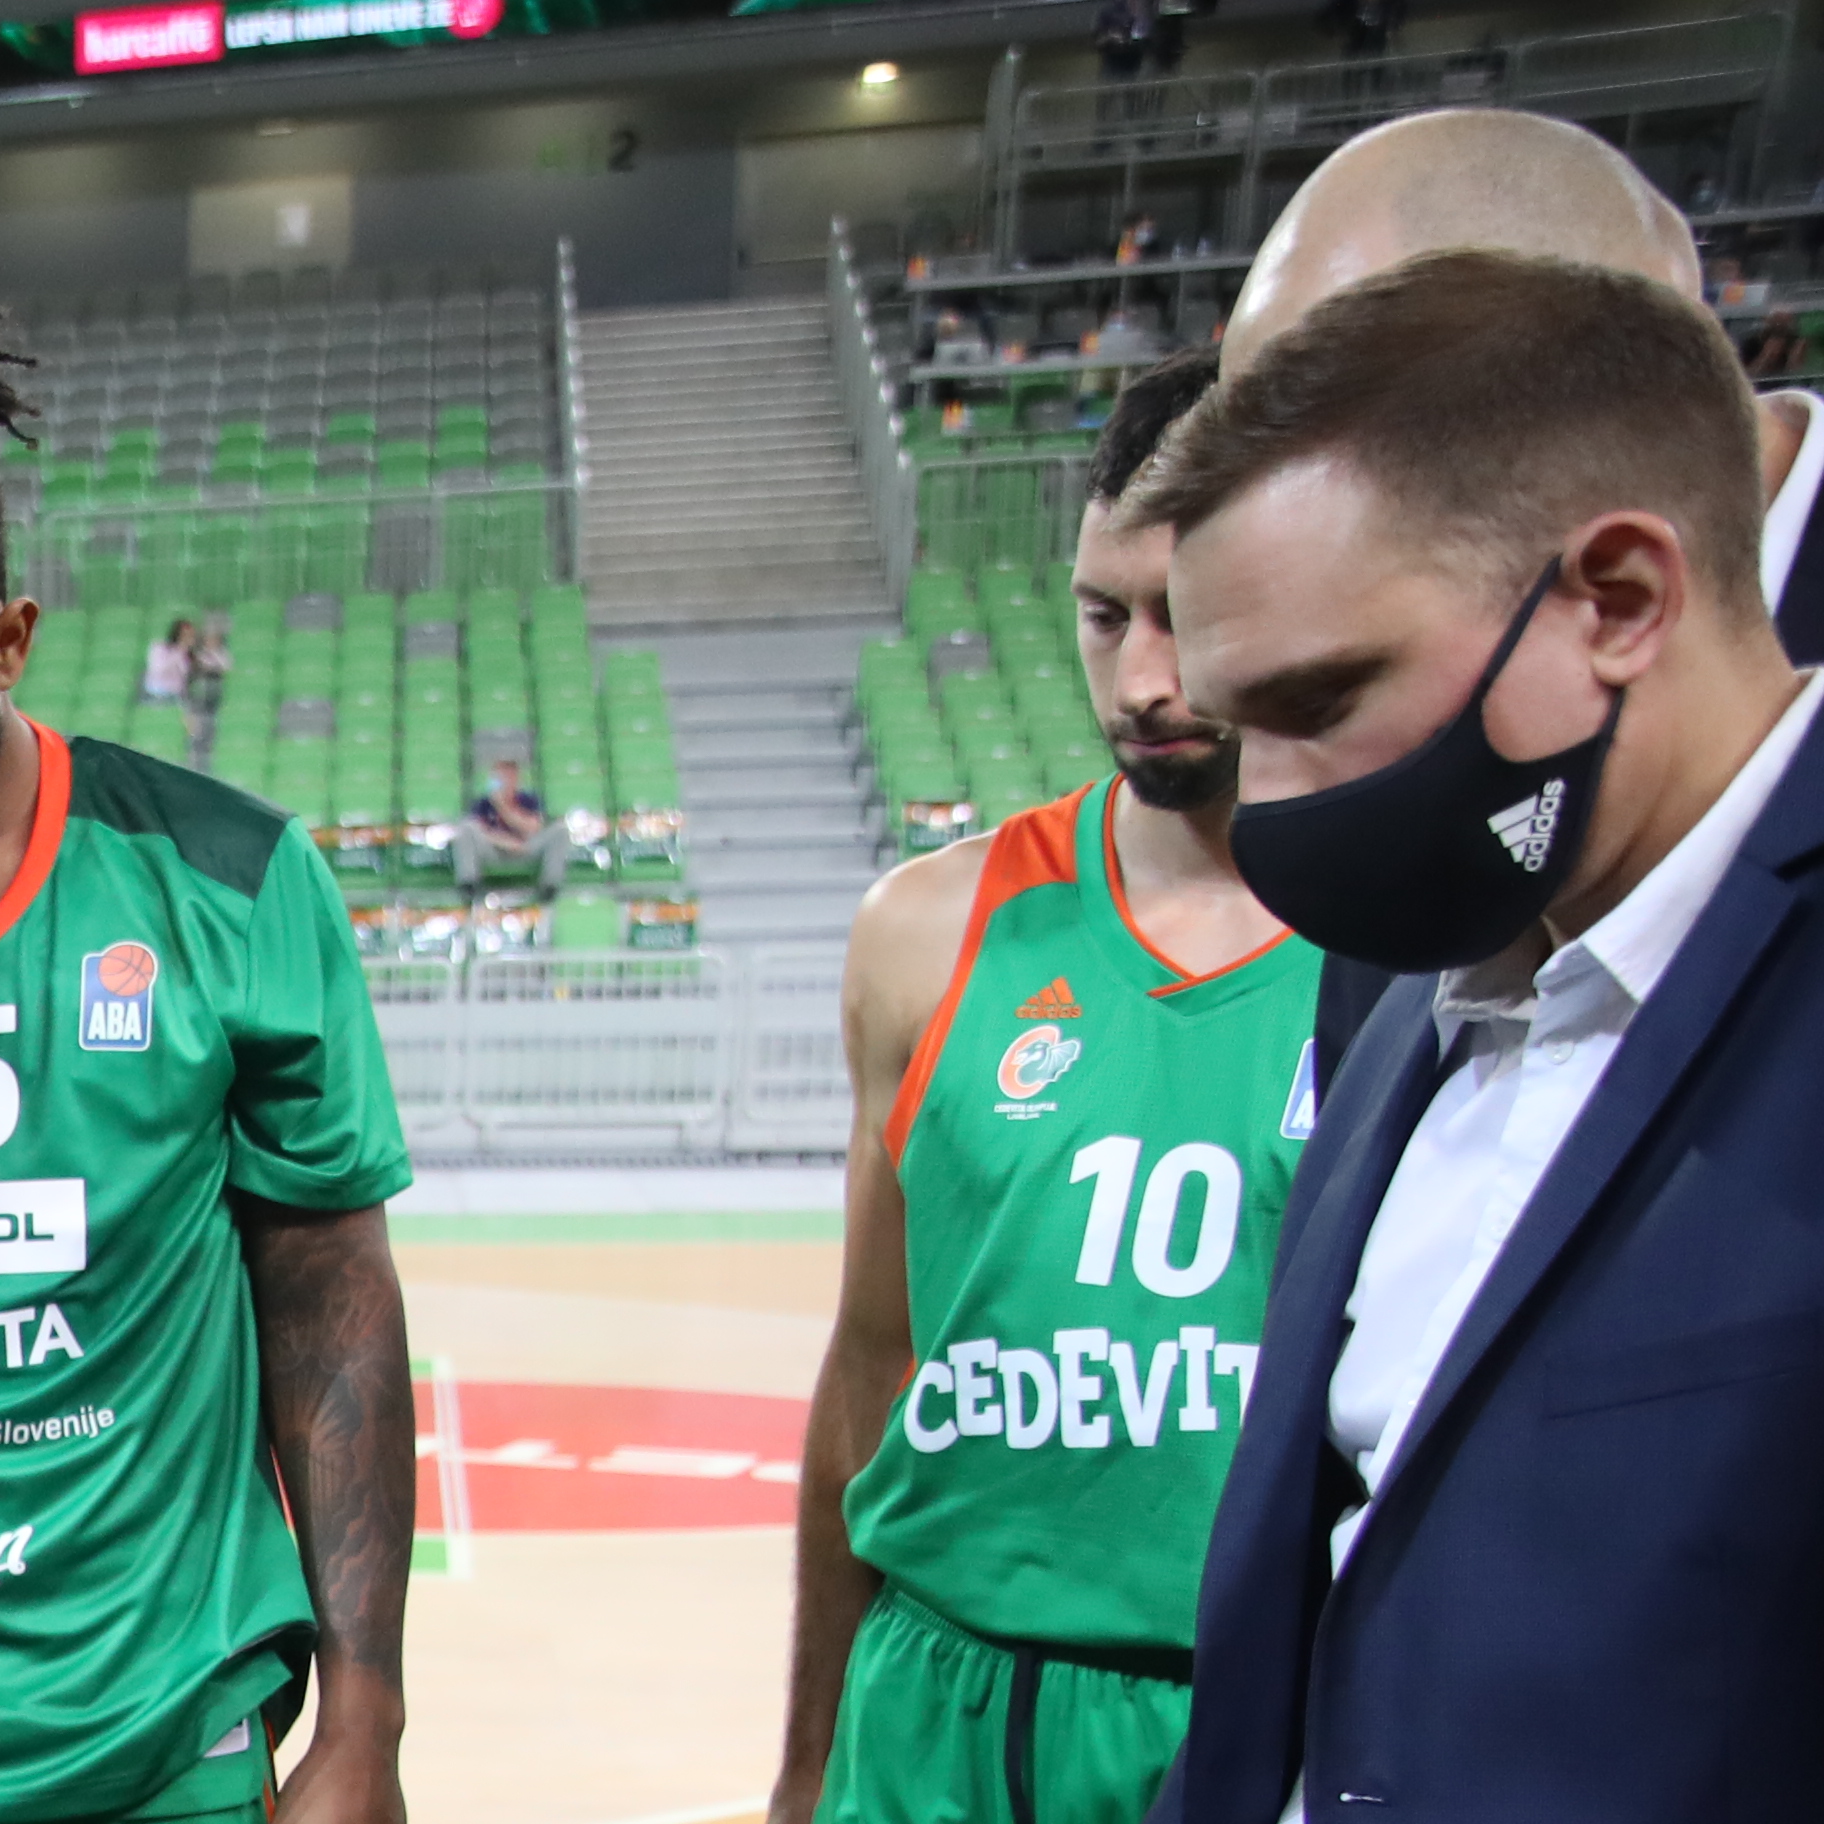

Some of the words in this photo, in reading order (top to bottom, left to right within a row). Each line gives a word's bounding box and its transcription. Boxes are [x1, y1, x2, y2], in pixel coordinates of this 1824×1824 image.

[1523, 778, 1567, 872] adidas
[88, 1002, 142, 1041] ABA
[1069, 1134, 1244, 1298] 10
